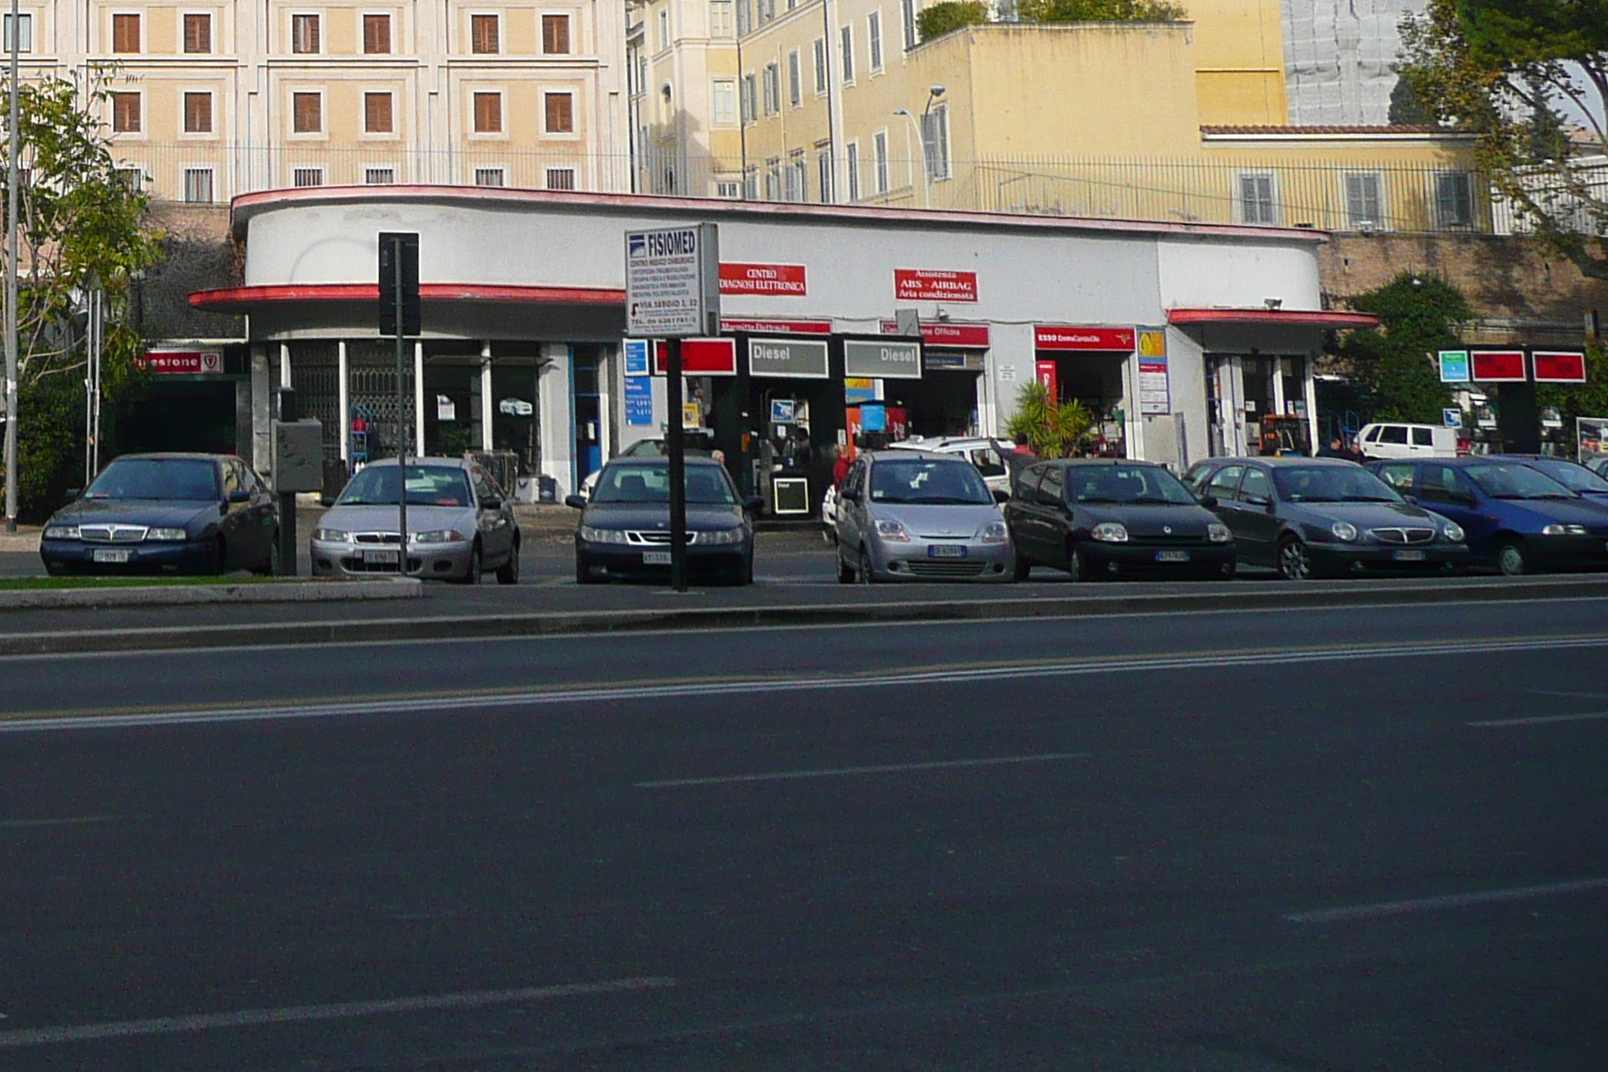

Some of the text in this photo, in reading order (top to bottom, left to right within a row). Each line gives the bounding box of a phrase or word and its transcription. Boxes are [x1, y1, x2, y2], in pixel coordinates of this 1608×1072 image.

[648, 230, 696, 257] FISIOMED
[747, 269, 776, 279] CENTRO
[915, 270, 957, 279] Assistenza
[719, 279, 804, 291] DIAGNOSI ELETTRONICA
[901, 279, 922, 288] ABS
[931, 280, 972, 291] AIRBAG
[899, 289, 974, 300] Aria condizionata
[754, 346, 790, 360] Diesel
[881, 349, 915, 362] Diesel
